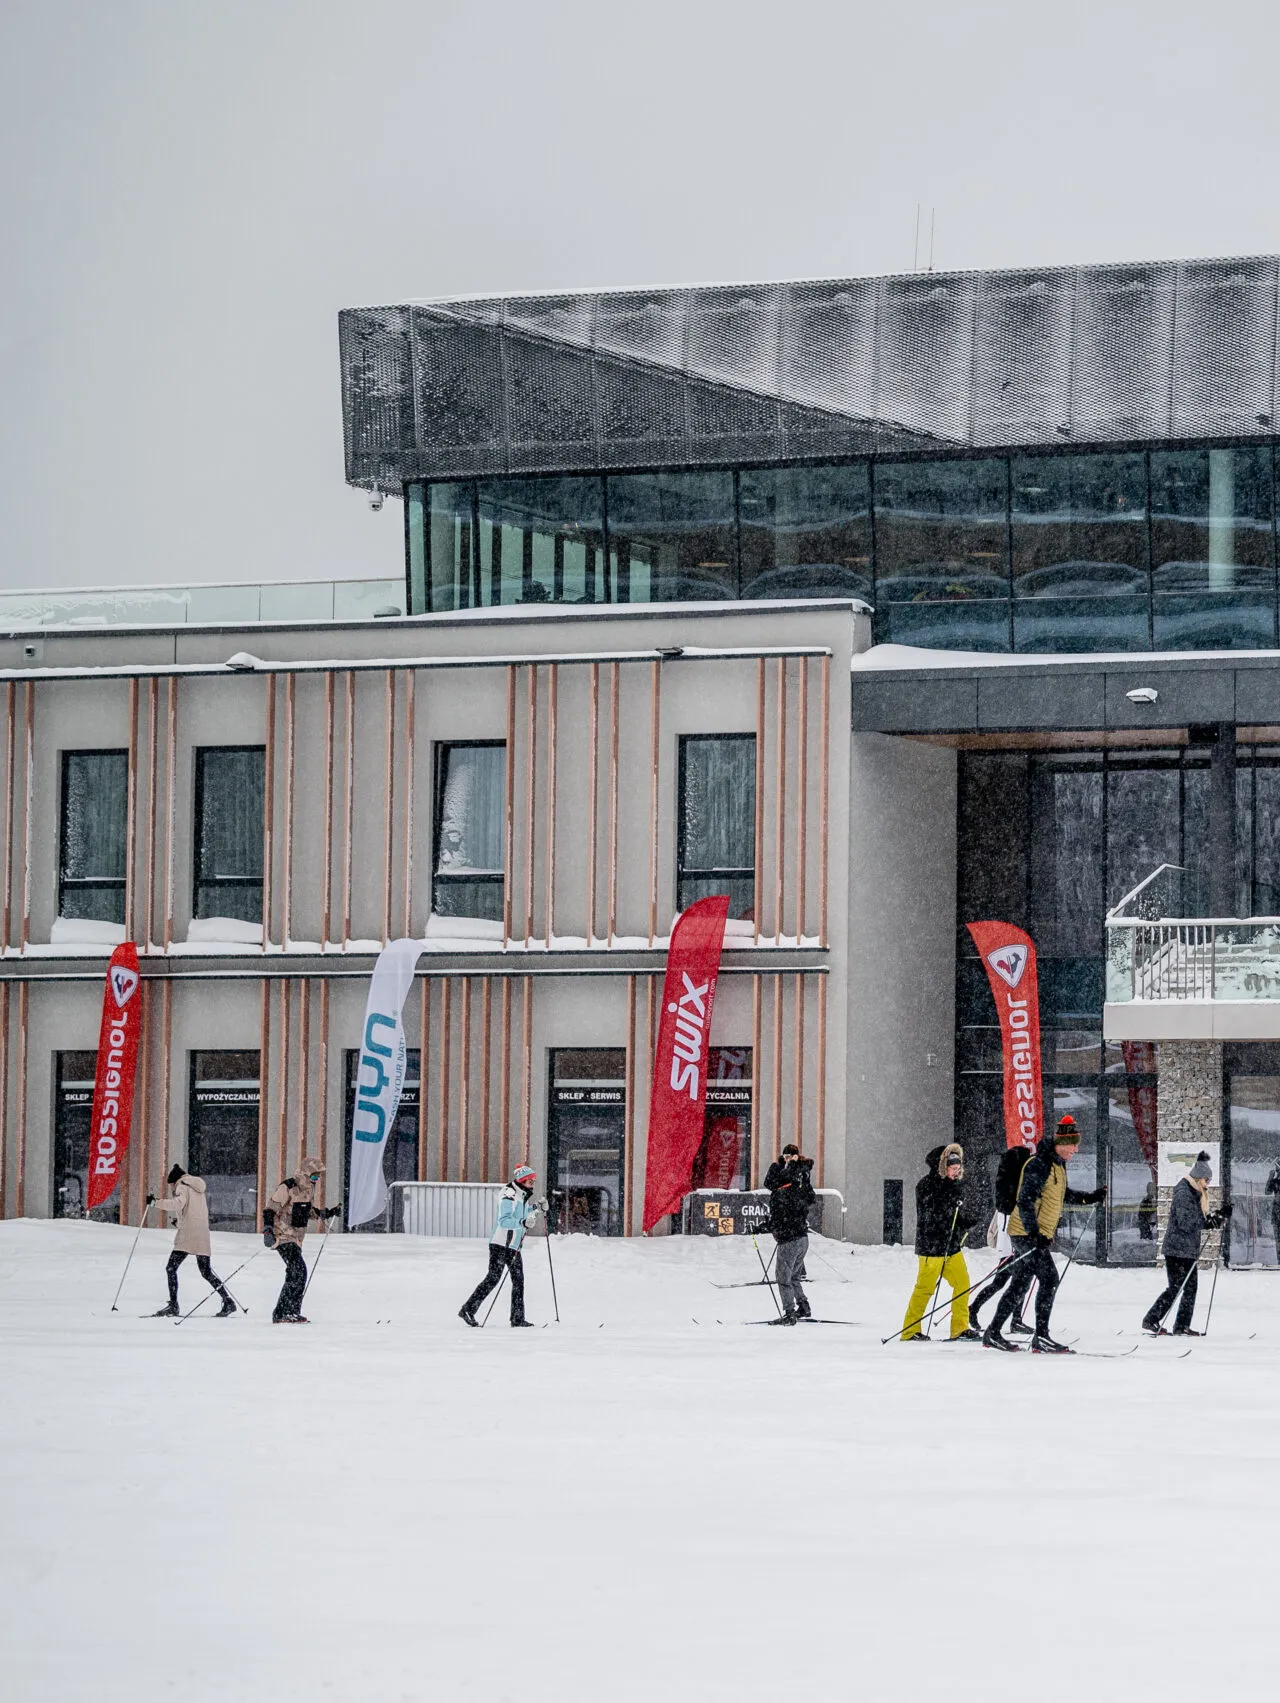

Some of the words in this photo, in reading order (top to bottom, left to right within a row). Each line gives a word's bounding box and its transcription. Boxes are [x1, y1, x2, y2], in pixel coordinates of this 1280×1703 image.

[394, 1064, 403, 1092] YOUR
[65, 1093, 89, 1101] SKLEP
[95, 1011, 128, 1175] ROSSIGNOL
[558, 1092, 584, 1100] SKLEP
[590, 1092, 621, 1100] SERWIS
[741, 1205, 765, 1216] GRA
